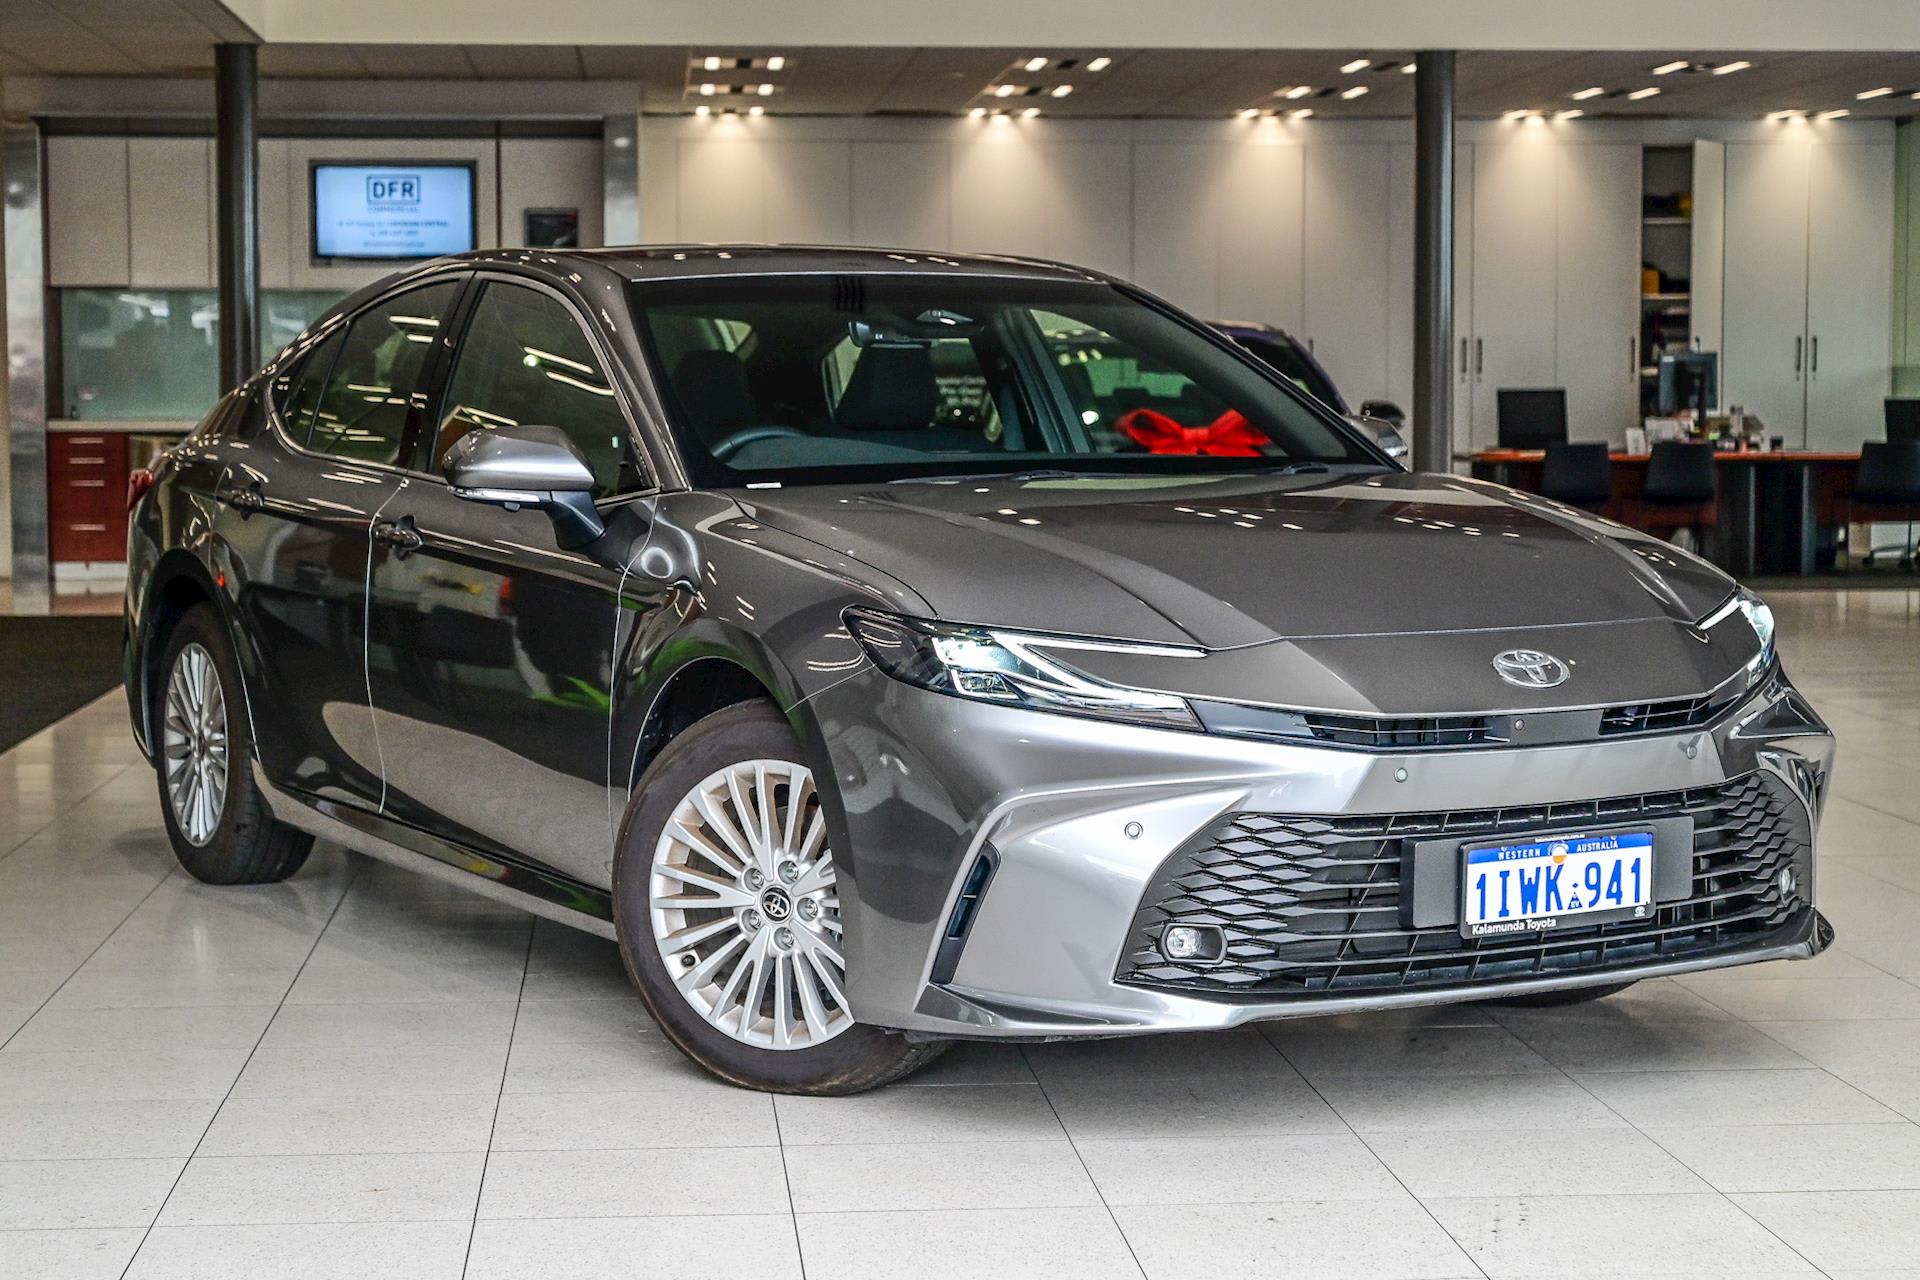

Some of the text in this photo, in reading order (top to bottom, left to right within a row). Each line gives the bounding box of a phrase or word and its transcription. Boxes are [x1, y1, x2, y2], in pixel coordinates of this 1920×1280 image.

[372, 181, 415, 199] DFR
[1498, 840, 1619, 861] WESTERN AUSTRALIA
[1476, 857, 1641, 920] 1IWK 941
[1472, 917, 1557, 935] Kalamunda Toyota
